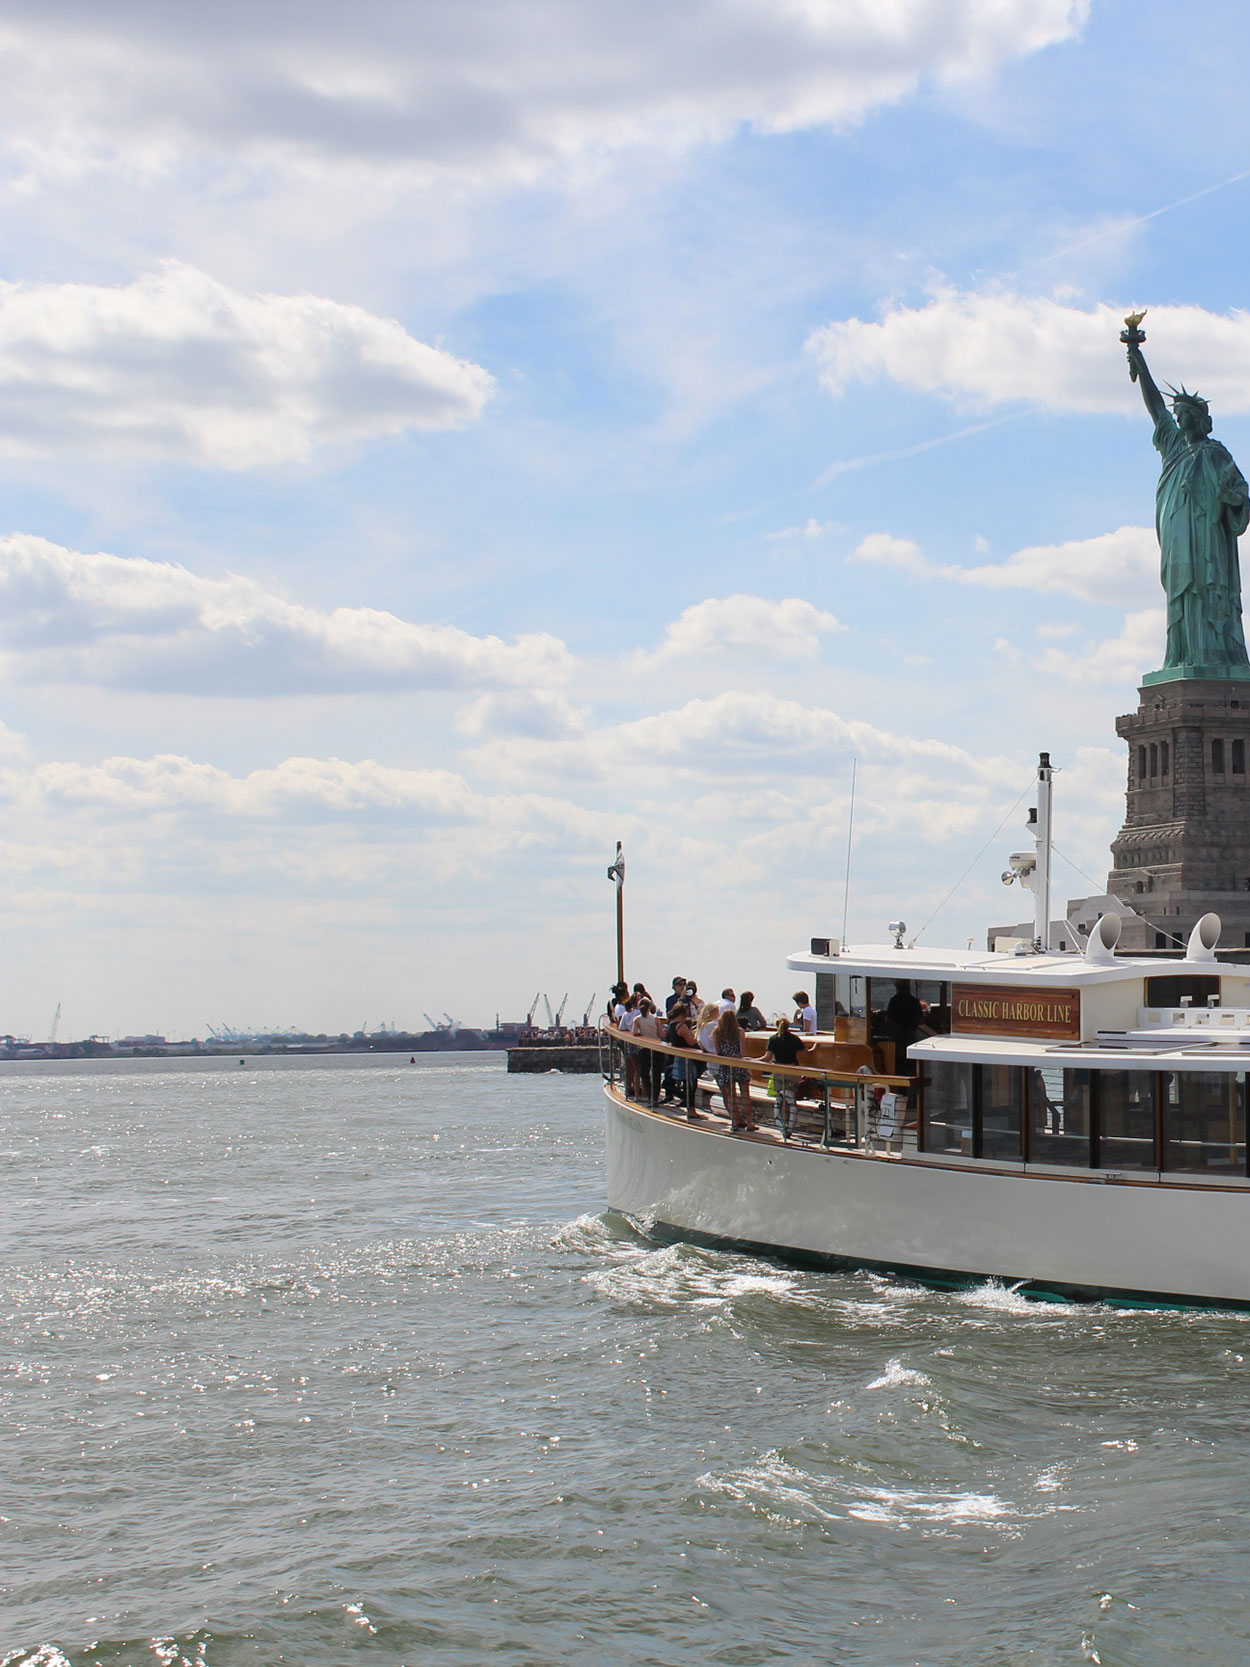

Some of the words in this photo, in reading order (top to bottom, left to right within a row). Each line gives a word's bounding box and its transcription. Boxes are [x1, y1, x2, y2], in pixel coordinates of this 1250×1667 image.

[958, 1000, 999, 1018] CLASSIC
[1002, 1002, 1044, 1021] HARBOR
[1047, 1004, 1071, 1023] LINE
